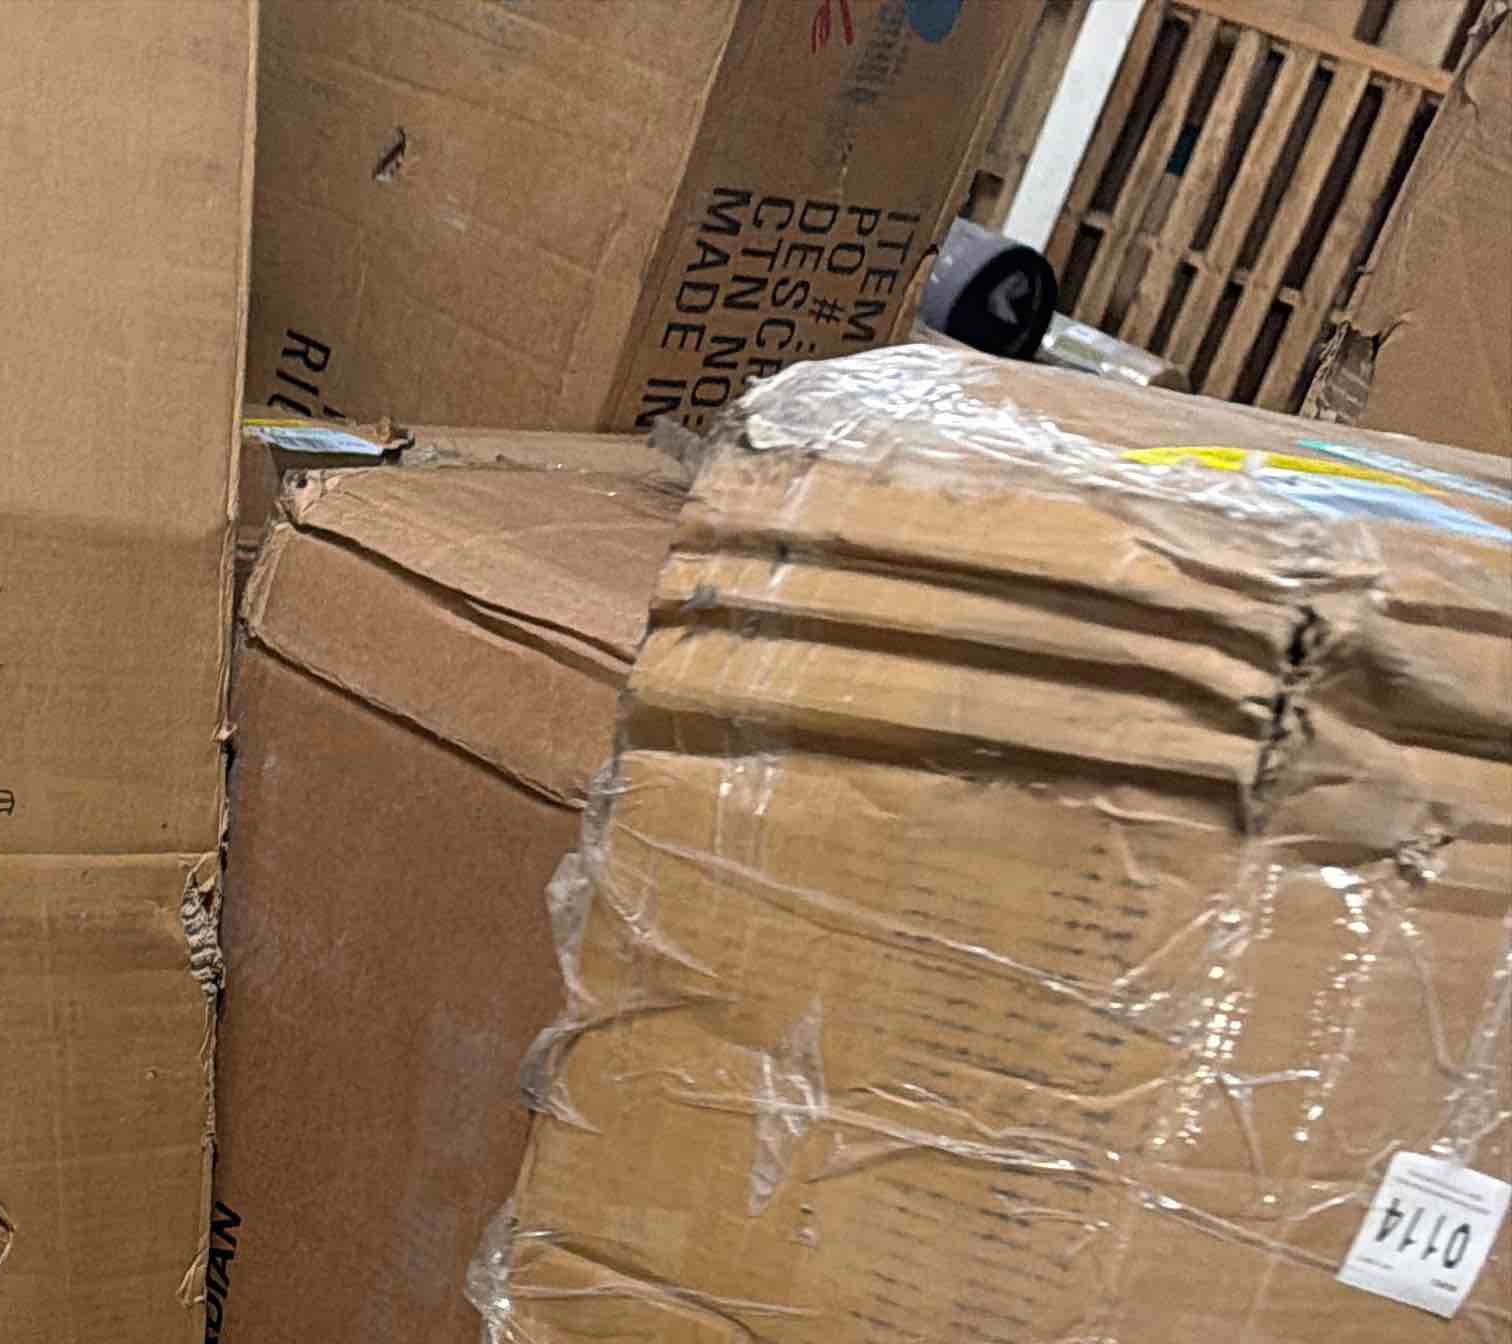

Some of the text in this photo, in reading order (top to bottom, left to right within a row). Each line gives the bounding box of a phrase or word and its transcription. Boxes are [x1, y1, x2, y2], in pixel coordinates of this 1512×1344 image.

[660, 188, 753, 351] MADE
[722, 197, 795, 310] CTN
[826, 206, 882, 275] PO
[1375, 1197, 1471, 1270] 0114
